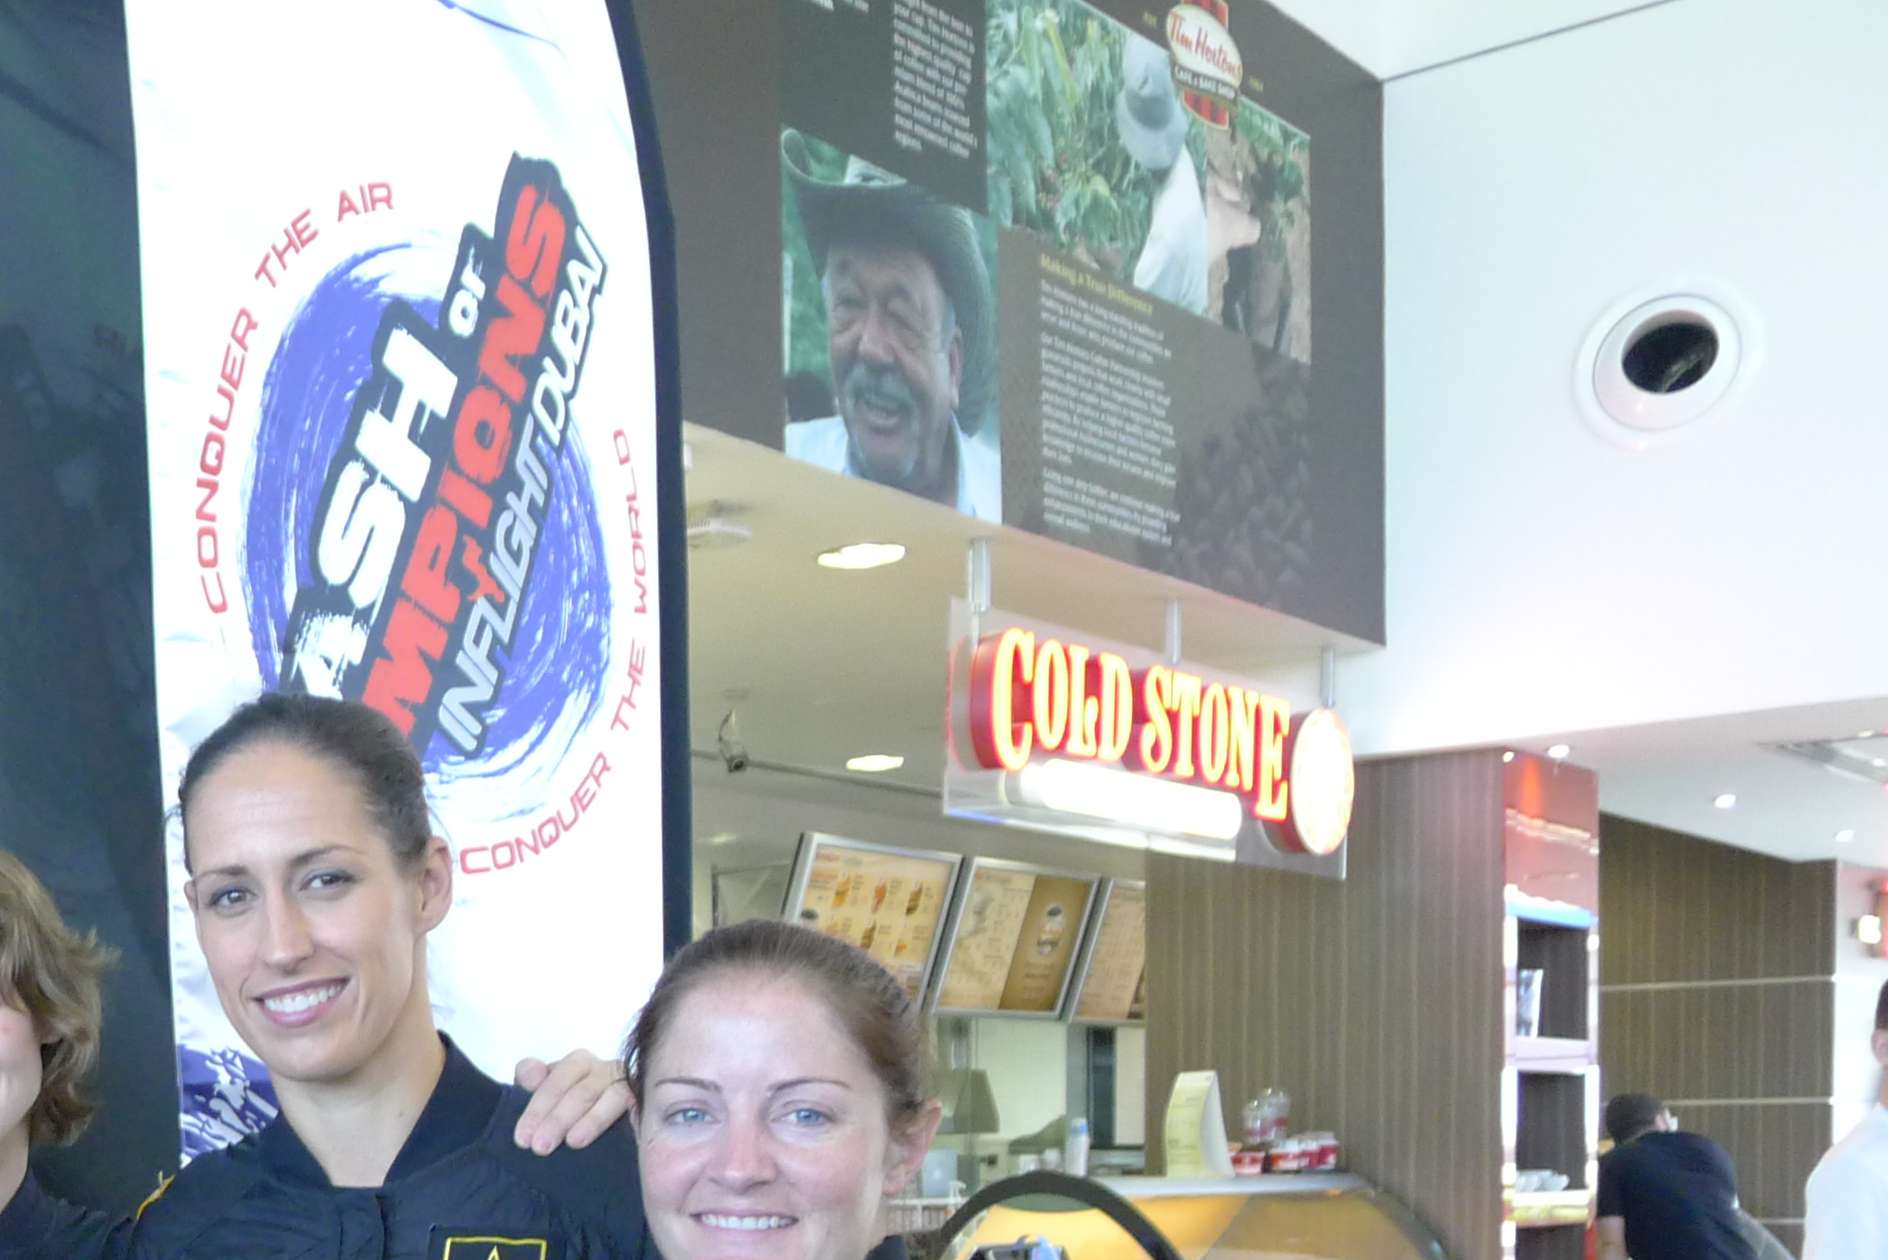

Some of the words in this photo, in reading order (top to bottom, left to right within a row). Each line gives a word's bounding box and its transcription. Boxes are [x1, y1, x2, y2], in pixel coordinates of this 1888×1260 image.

[195, 307, 259, 614] CONQUER
[255, 209, 318, 288] THE
[336, 183, 394, 223] AIR
[292, 328, 458, 700] ASH
[449, 248, 486, 337] OF
[363, 184, 566, 736] MPIONS
[438, 415, 549, 752] INFLIGHT
[532, 227, 606, 445] DUBAI
[614, 429, 647, 613] WORLD
[460, 752, 612, 876] CONQUER
[610, 639, 645, 733] THE
[992, 626, 1132, 772] COLD
[1141, 664, 1290, 821] STONE
